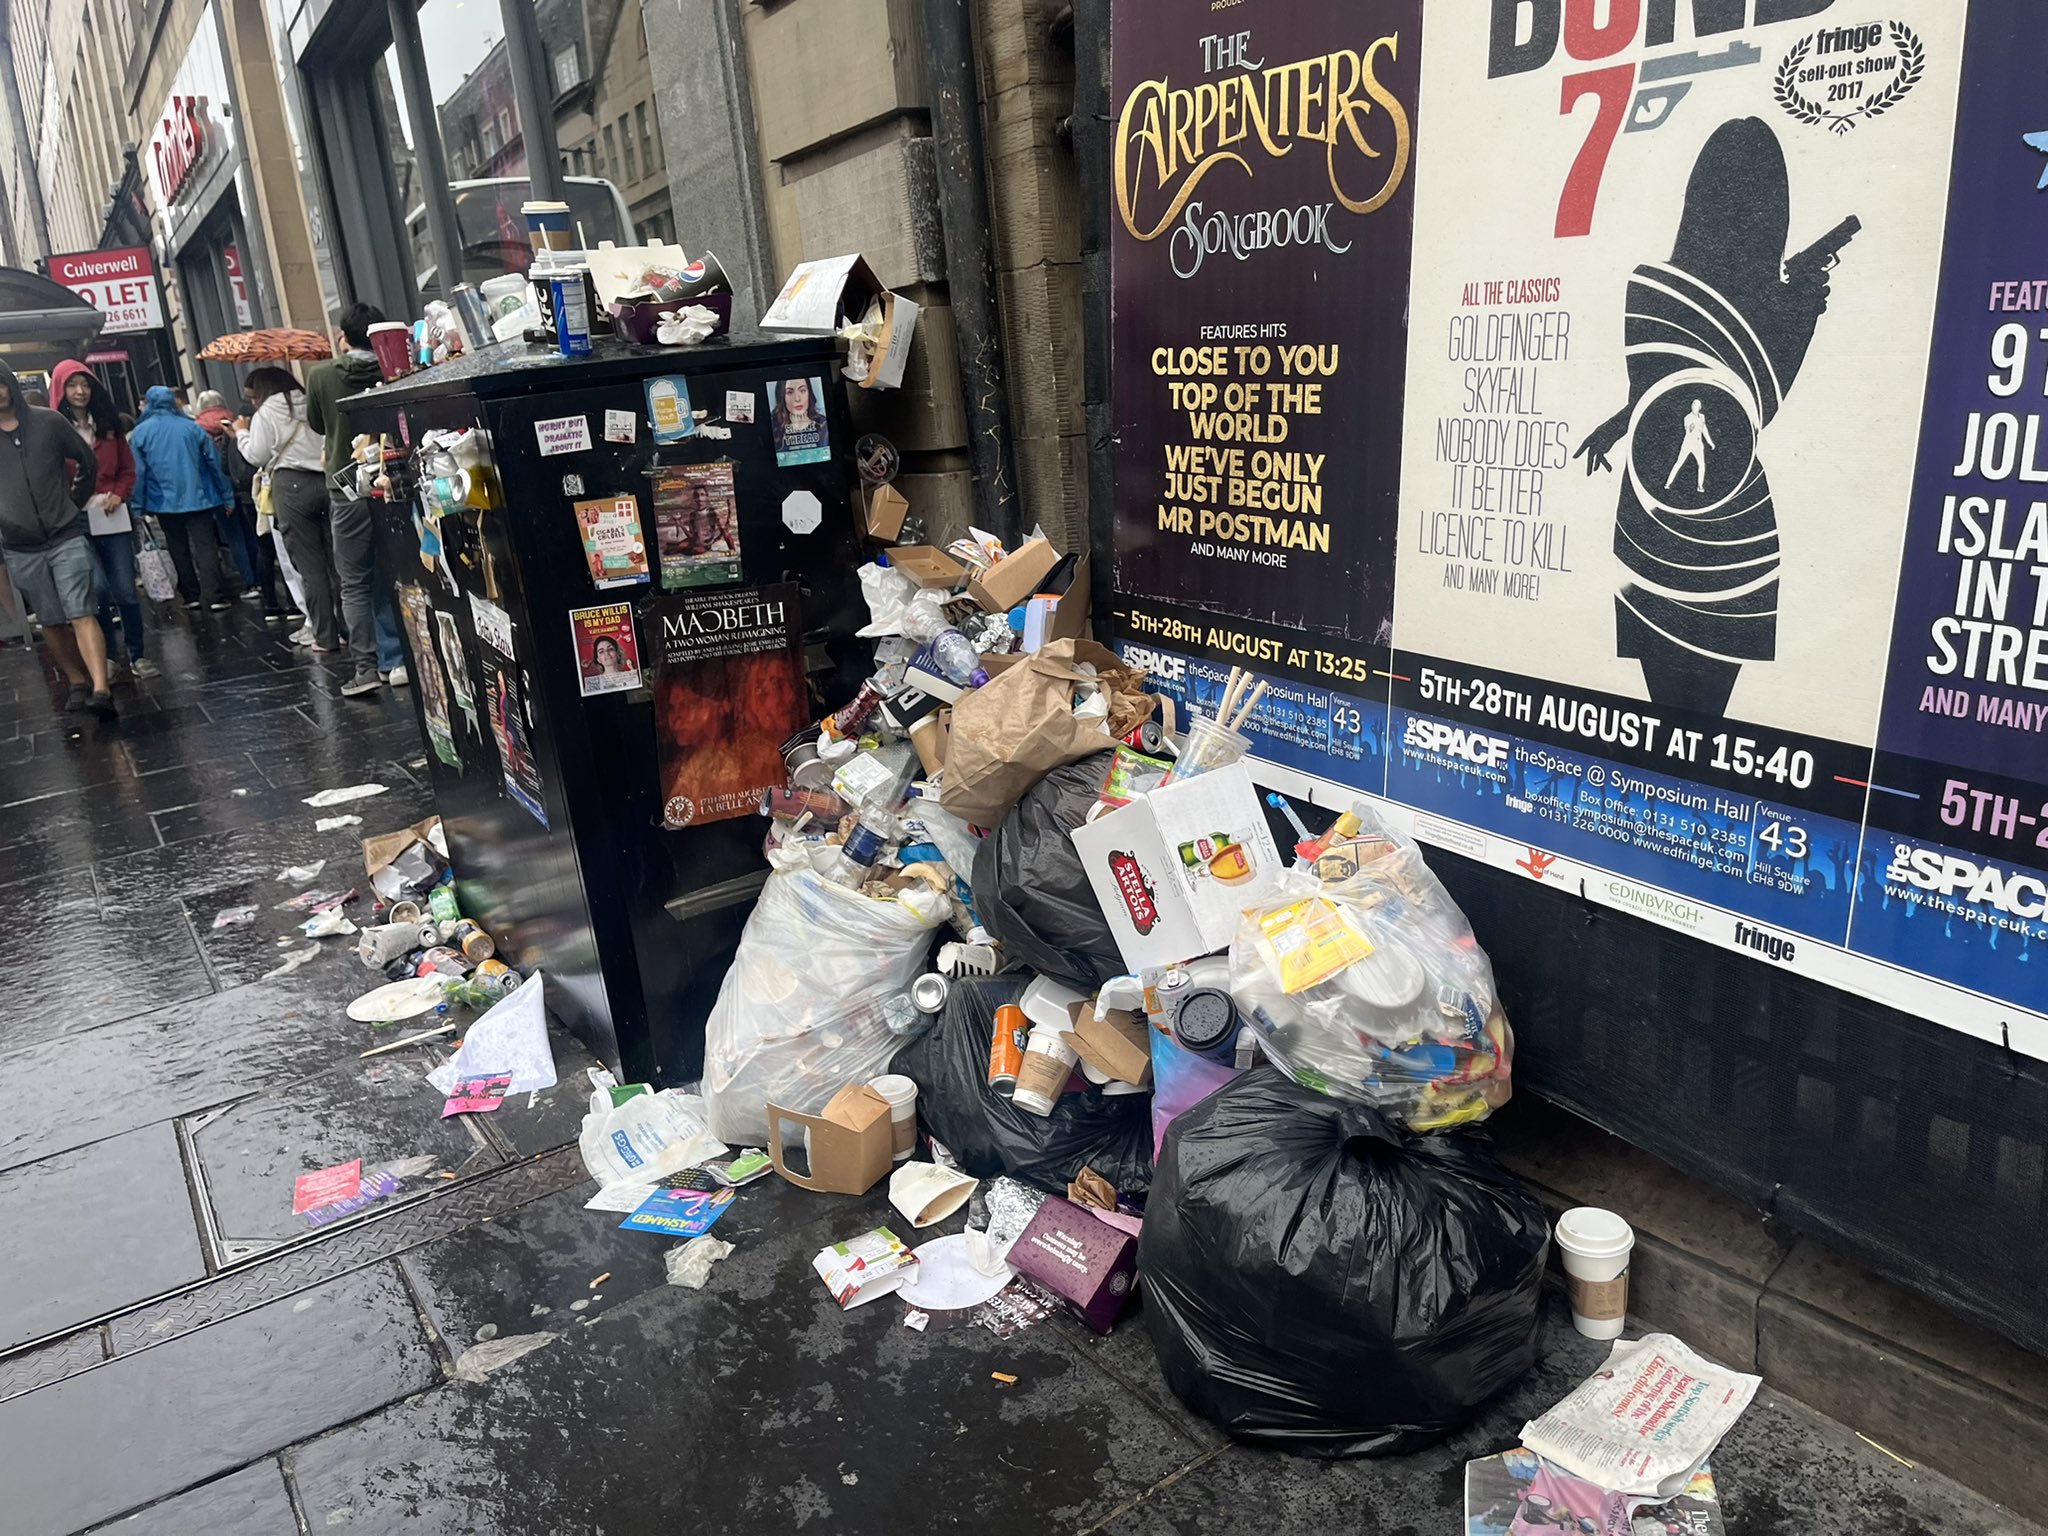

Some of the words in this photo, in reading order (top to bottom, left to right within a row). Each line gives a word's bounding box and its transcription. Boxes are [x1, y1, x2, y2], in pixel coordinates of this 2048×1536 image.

[1199, 30, 1265, 74] THE
[1816, 23, 1882, 55] fringe
[1856, 55, 1897, 75] show
[1827, 80, 1863, 102] 2017
[1114, 32, 1410, 242] CARPENTERS
[1170, 201, 1352, 279] SONGBOOK
[63, 255, 138, 278] Culverwell
[105, 281, 150, 306] LET
[1462, 282, 1480, 306] ALL
[1484, 281, 1504, 305] THE
[1507, 277, 1561, 304] CLASSICS
[123, 308, 147, 321] 6611
[540, 286, 557, 334] KFC
[1200, 324, 1257, 340] FEATURES
[1260, 323, 1287, 338] HITS
[1448, 311, 1571, 361] GOLDFINGER
[1151, 345, 1228, 376] CLOSE
[1233, 345, 1271, 376] TO
[1277, 344, 1339, 376] YOU
[1987, 322, 2028, 397] 9
[1168, 382, 1218, 411] TOP
[1223, 382, 1261, 412] OF
[1266, 383, 1322, 414] THE
[1463, 367, 1543, 415] SKYFALL
[538, 420, 566, 433] HORNY
[568, 418, 584, 428] BUT
[544, 430, 583, 444] DRAMATIC
[784, 432, 820, 446] THREAD
[1189, 411, 1288, 443] WORLD
[550, 443, 574, 453] ABOUT
[575, 441, 582, 449] IT
[1436, 417, 1510, 466] NOBODY
[1515, 420, 1569, 470] DOES
[1164, 444, 1245, 477] WE'VE
[1251, 450, 1326, 484] ONLY
[1164, 472, 1222, 504] JUST
[1228, 477, 1322, 515] BEGUN
[1451, 464, 1468, 509] IT
[1471, 466, 1544, 517] BETTER
[596, 526, 624, 536] CICADA'S
[597, 532, 625, 541] CHILDREN
[1158, 504, 1193, 535] MR
[1199, 509, 1330, 553] POSTMAN
[1419, 510, 1496, 562] LICENCE
[1502, 518, 1525, 566] TO
[1531, 521, 1572, 573] KILL
[1190, 542, 1214, 557] AND
[1216, 545, 1250, 562] MANY
[1252, 550, 1287, 568] MORE
[1443, 563, 1464, 591] AND
[1469, 566, 1499, 595] MANY
[1503, 572, 1540, 602] MORE!
[1955, 558, 2012, 621] IN
[574, 609, 600, 621] BRUCE
[601, 605, 628, 617] WILLIS
[584, 619, 592, 628] IS
[593, 618, 605, 627] MY
[605, 615, 621, 625] DAD
[684, 603, 712, 611] WILLIAM
[665, 641, 672, 650] A
[672, 638, 694, 647] TWO
[695, 633, 730, 645] WOMAN
[730, 626, 786, 640] REIMAGINING
[1131, 610, 1201, 645] 5TH-28TH
[1206, 627, 1283, 662] AUGUST
[1287, 648, 1310, 669] AT
[1314, 650, 1367, 682] 13:25
[1189, 663, 1229, 685] theSpace
[1307, 692, 1328, 710] Hall
[1333, 696, 1350, 708] Venue
[1266, 706, 1286, 718] 0131
[1288, 710, 1304, 722] 510
[1306, 715, 1327, 729] 2385
[1333, 707, 1361, 734] 43
[1919, 685, 1970, 719] AND
[1976, 695, 2048, 733] MANY
[1261, 726, 1327, 752] www.edfringe.com
[1419, 667, 1532, 723] 5TH-28TH
[1537, 694, 1661, 752] AUGUST
[1666, 729, 1702, 763] AT
[1710, 733, 1815, 790] 15:40
[1331, 737, 1342, 749] Hill
[1343, 740, 1363, 754] Square
[1402, 748, 1506, 784] www.thespaceuk.com
[1515, 747, 1582, 776] theSpace
[1587, 765, 1605, 787] @
[1610, 770, 1707, 811] Symposium
[1714, 797, 1750, 822] Hall
[700, 805, 714, 815] LA
[715, 799, 745, 812] BELLE
[1580, 790, 1601, 806] Box
[1604, 798, 1639, 817] Office:
[1643, 809, 1674, 828] 0131
[1680, 819, 1706, 836] 510
[1711, 828, 1747, 847] 2385
[1760, 805, 1792, 823] Venue
[1506, 794, 1536, 815] fringe:
[1539, 807, 1568, 824] 0131
[1572, 817, 1595, 832] 226
[1598, 825, 1630, 842] 0000
[1633, 836, 1743, 878] www.edfringe.com
[1525, 788, 1745, 863] boxoffice.symposium@thespaceuk.com
[1759, 821, 1807, 858] 43
[1550, 870, 1564, 881] Hand
[1753, 872, 1774, 886] EH8
[1777, 879, 1803, 896] 9DW
[1754, 860, 1771, 874] Hill
[1774, 866, 1810, 886] Square
[1116, 866, 1145, 920] ARTOIS
[1124, 862, 1150, 918] STELLA
[1609, 882, 1699, 923] EDINBVRGH
[1733, 920, 1796, 963] fringe
[631, 1213, 706, 1230] UNASHAMED
[1645, 1354, 1666, 1377] Clans
[1632, 1375, 1649, 1393] club
[1643, 1365, 1682, 1402] Gathering
[1675, 1374, 1696, 1395] head
[1691, 1381, 1710, 1396] Top
[1647, 1399, 1677, 1431] Shetland
[1671, 1394, 1699, 1422] Scottish
